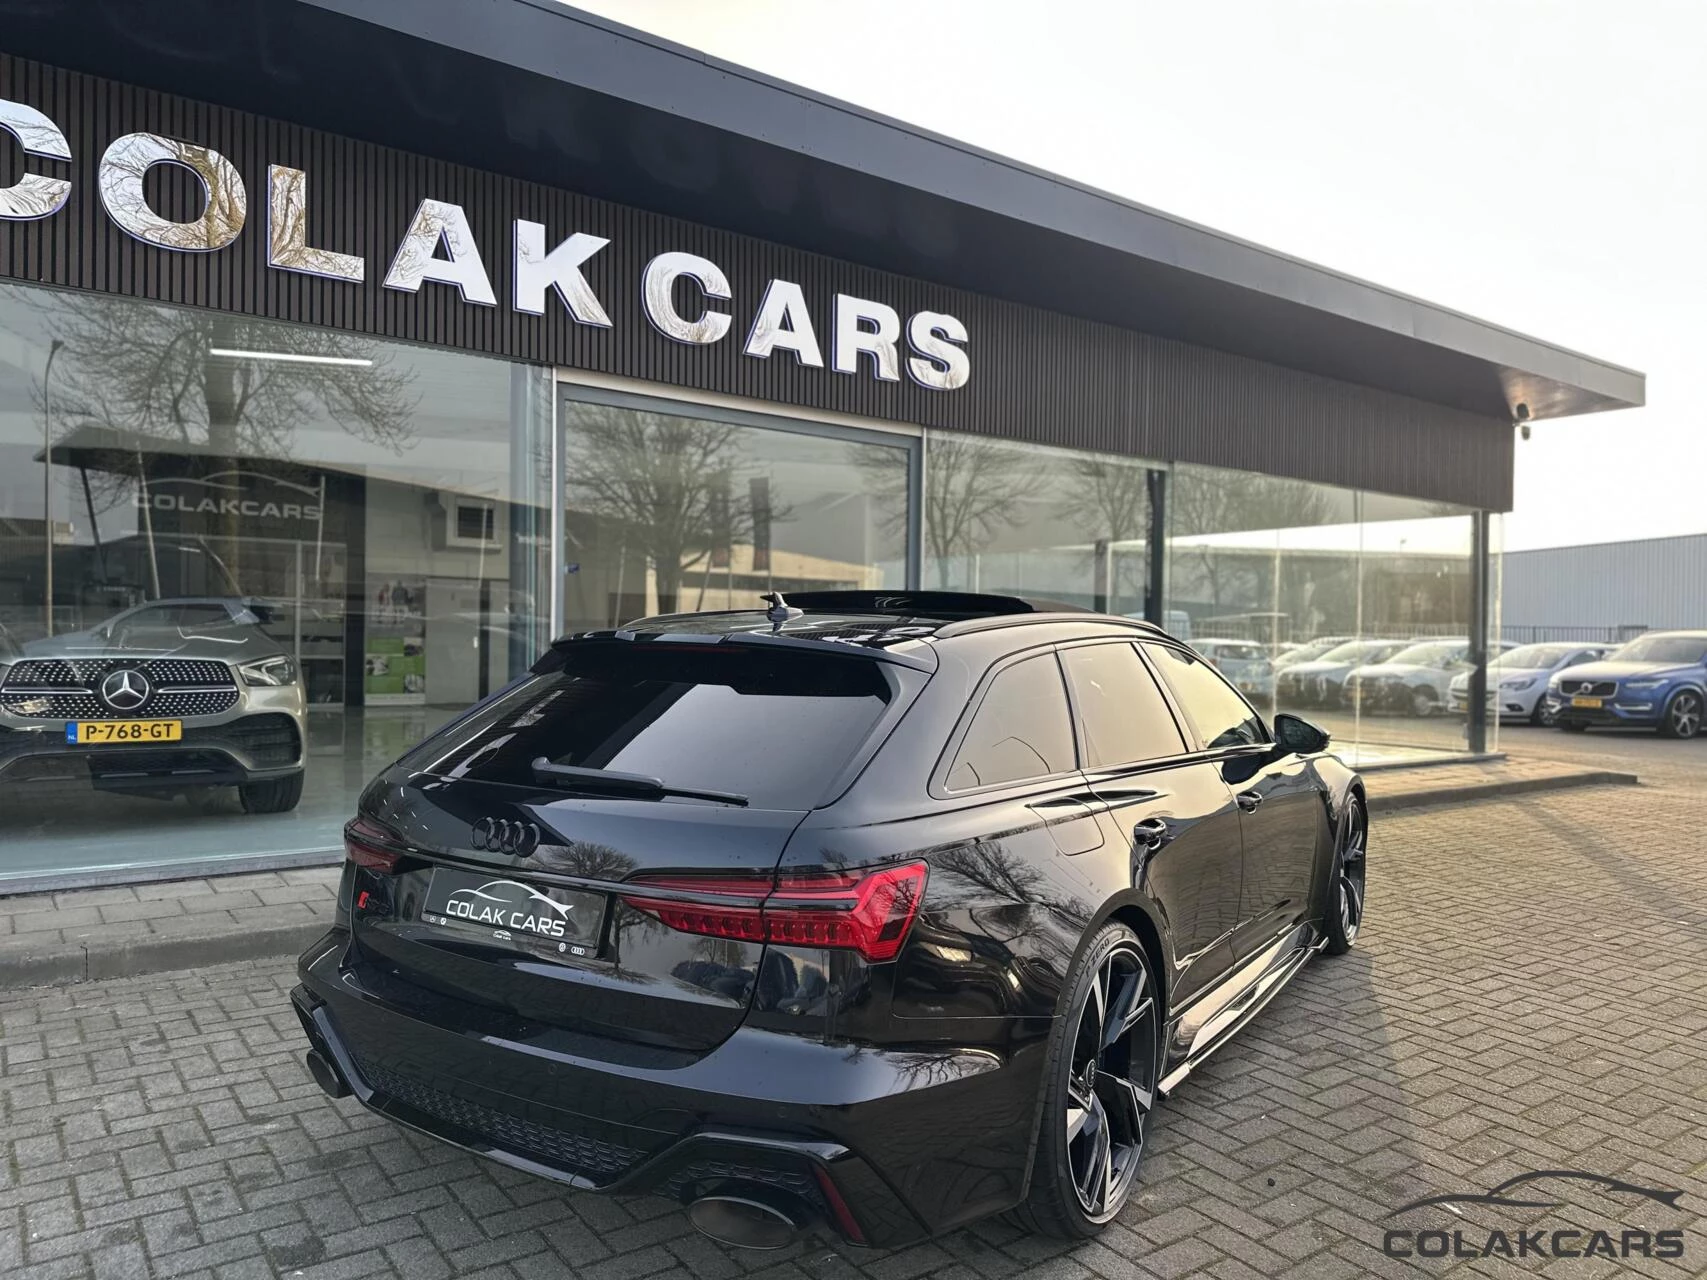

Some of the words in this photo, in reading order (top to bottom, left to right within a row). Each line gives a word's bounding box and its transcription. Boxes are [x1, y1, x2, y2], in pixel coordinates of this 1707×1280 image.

[641, 252, 970, 390] CARS
[133, 493, 324, 520] COLAKCARS
[85, 723, 174, 741] P-768-GT
[446, 899, 504, 926] COLAK
[510, 912, 566, 937] CARS
